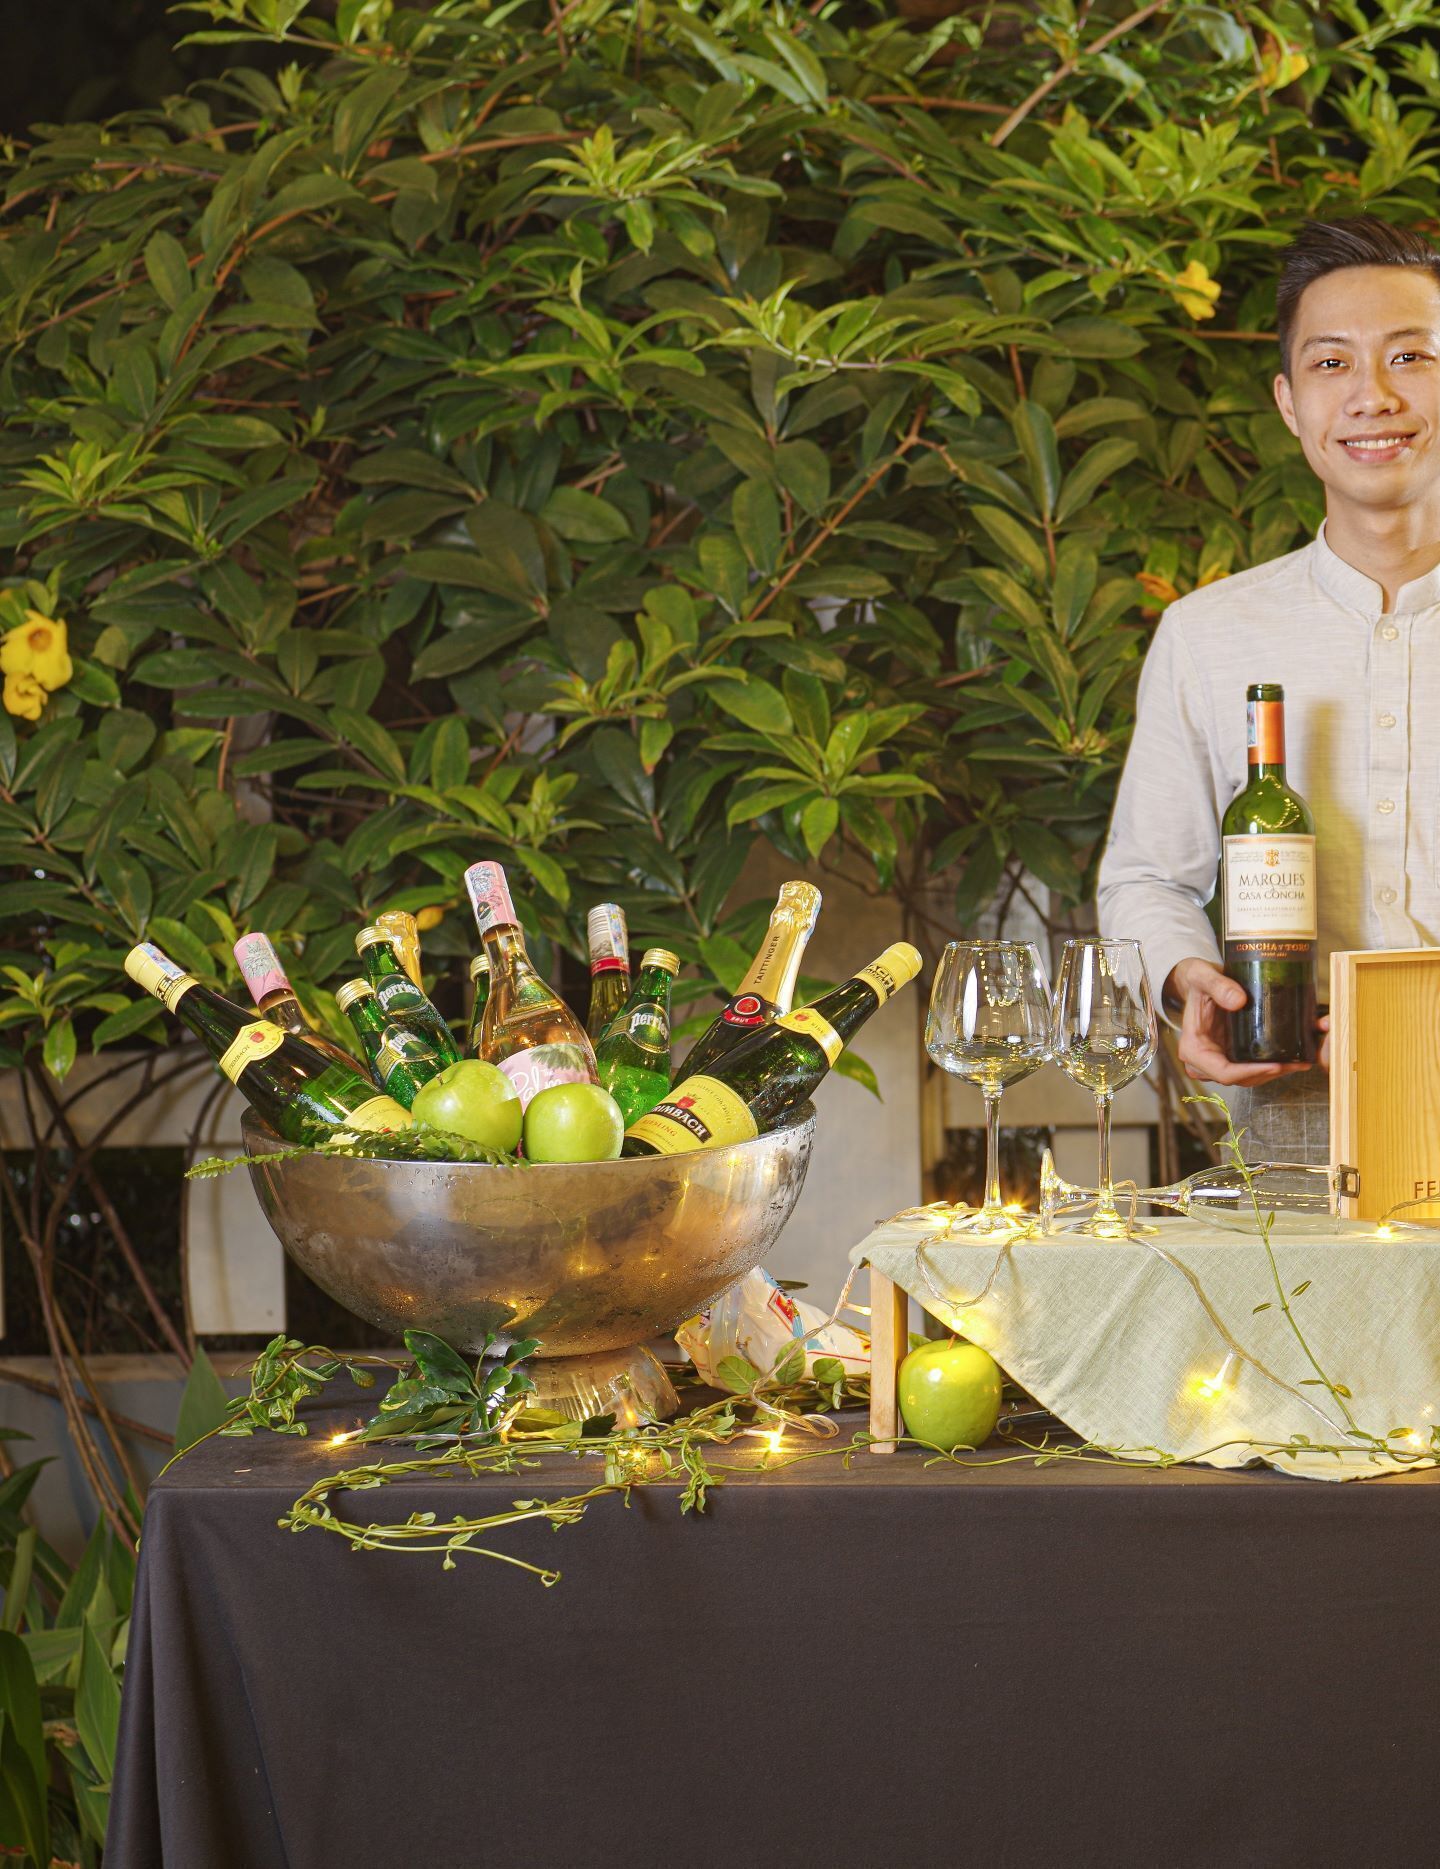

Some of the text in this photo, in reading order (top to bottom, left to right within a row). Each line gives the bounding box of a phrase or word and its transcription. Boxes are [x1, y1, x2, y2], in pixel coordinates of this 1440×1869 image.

[1239, 872, 1305, 887] MARQUES
[1239, 890, 1305, 900] CASA CONCHA
[1236, 943, 1277, 951] CONCHA
[754, 936, 779, 985] TAITTINGER
[378, 981, 421, 1012] perrier
[652, 1104, 708, 1138] RIMBACH
